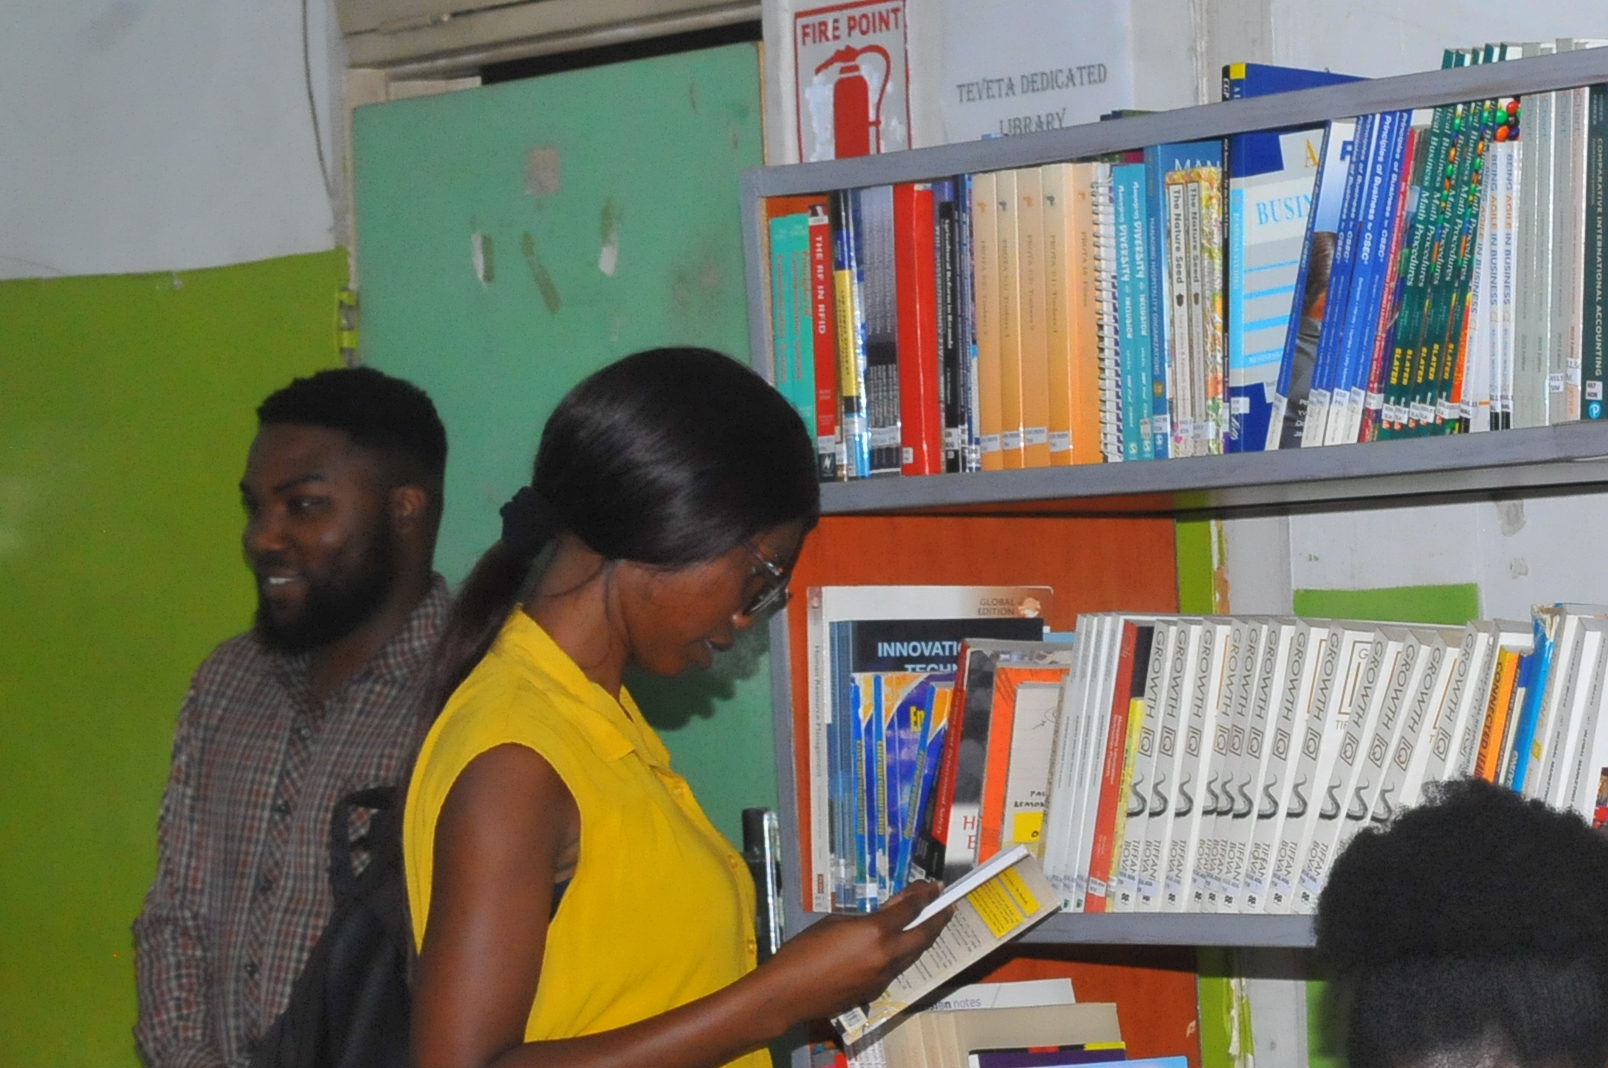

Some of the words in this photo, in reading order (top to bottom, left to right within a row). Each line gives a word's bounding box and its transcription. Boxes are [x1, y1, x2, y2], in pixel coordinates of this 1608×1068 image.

[801, 18, 840, 46] FIRE
[847, 7, 901, 38] POINT
[956, 77, 1016, 103] TEVETA
[1020, 63, 1108, 94] DEDICATED
[1000, 107, 1067, 136] LIBRARY
[1490, 195, 1498, 229] AGILE
[1174, 209, 1182, 255] Nature
[1491, 233, 1497, 246] IN
[815, 235, 824, 262] THE
[816, 264, 825, 282] RF
[1175, 258, 1184, 284] Seed
[1490, 250, 1498, 306] BUSINESS
[817, 285, 825, 301] IN
[817, 303, 827, 335] RFID
[977, 607, 1015, 616] EDITION
[979, 598, 1015, 607] GLOBAL
[877, 641, 964, 658] INNOVATI
[1192, 629, 1212, 718] GROWTH
[1352, 641, 1383, 728] GROWTH
[1445, 633, 1473, 722] GROWTH
[1482, 662, 1502, 750] CONNECTED
[953, 998, 981, 1008] notes
